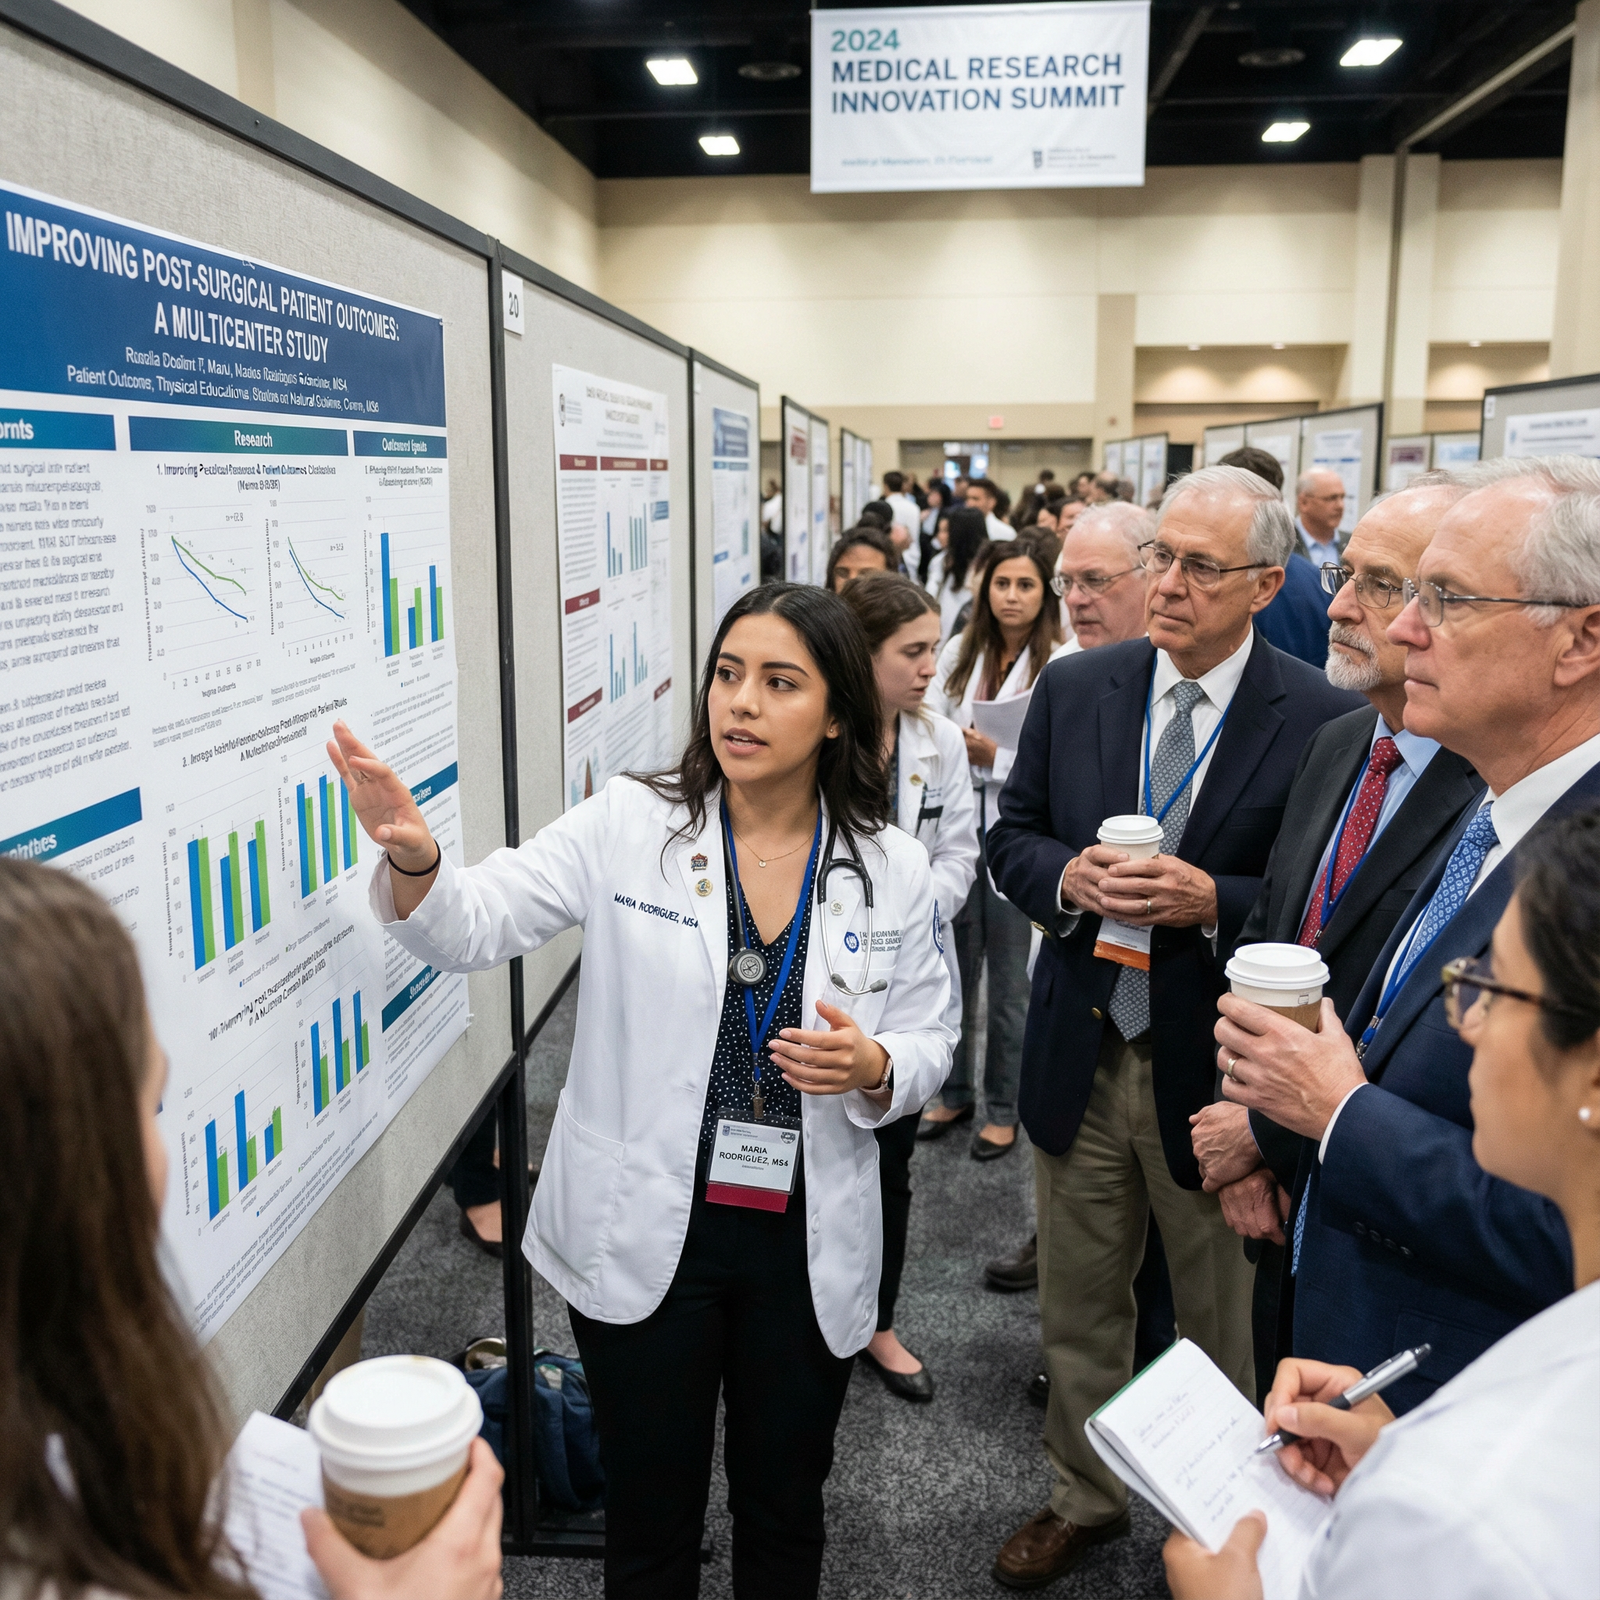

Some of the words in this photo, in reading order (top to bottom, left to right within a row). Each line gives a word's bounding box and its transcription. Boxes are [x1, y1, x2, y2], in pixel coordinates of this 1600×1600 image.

[831, 28, 900, 52] 2024
[832, 58, 957, 82] MEDICAL
[968, 53, 1122, 79] RESEARCH
[832, 88, 1001, 114] INNOVATION
[1011, 84, 1125, 109] SUMMIT
[6, 210, 139, 279] IMPROVING
[143, 248, 278, 314] POST-SURGICAL
[281, 285, 333, 326] PATIENT
[336, 306, 400, 342] OUTCOMES:
[508, 291, 519, 318] 20
[154, 302, 168, 335] A
[173, 303, 284, 356] MULTICENTER
[286, 330, 329, 363] STUDY
[67, 364, 107, 386] Patient
[233, 429, 273, 448] Research
[614, 892, 636, 909] MARIA
[638, 901, 680, 923] RODRIGUEZ,
[719, 1151, 770, 1167] RODRIGUEZ,
[740, 1144, 768, 1155] MARIA
